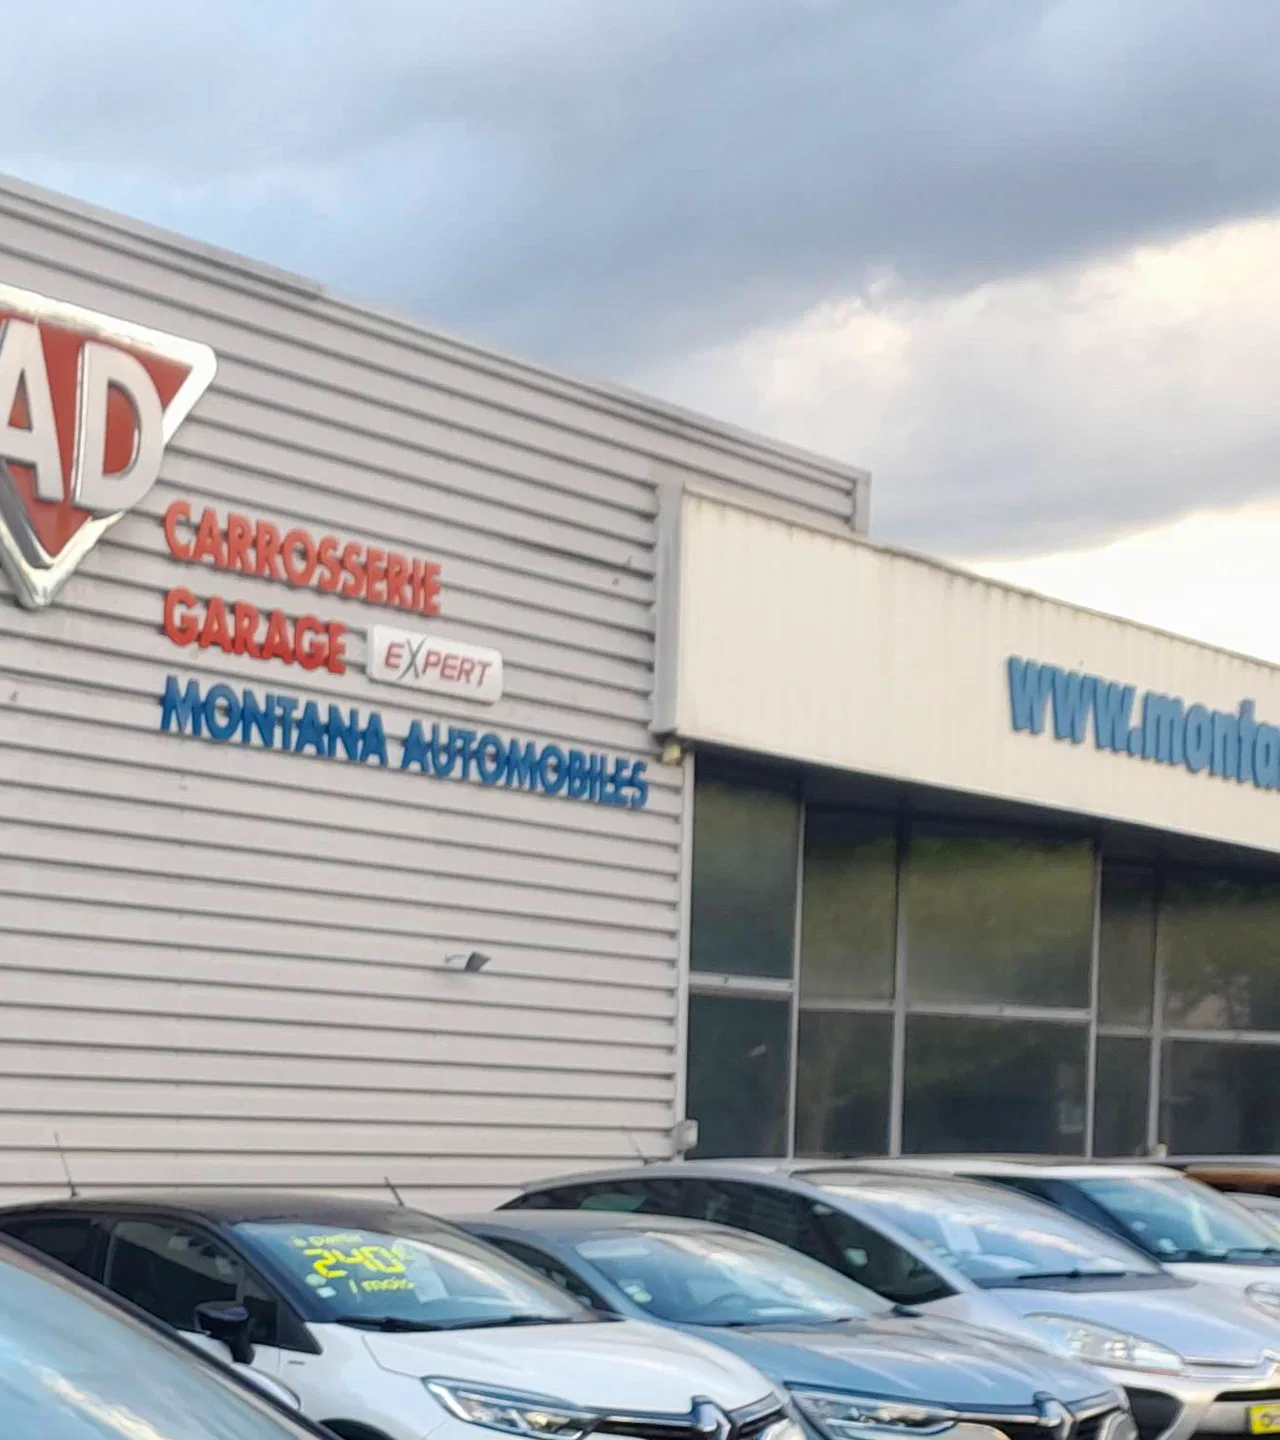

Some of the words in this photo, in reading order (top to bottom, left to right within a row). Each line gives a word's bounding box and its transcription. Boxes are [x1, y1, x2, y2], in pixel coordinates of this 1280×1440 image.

[162, 499, 442, 618] CARROSSERIE
[162, 589, 348, 676] GARAGE
[383, 636, 493, 688] EXPERT
[159, 675, 388, 770] MONTANA
[399, 719, 650, 809] AUTOMOBILES
